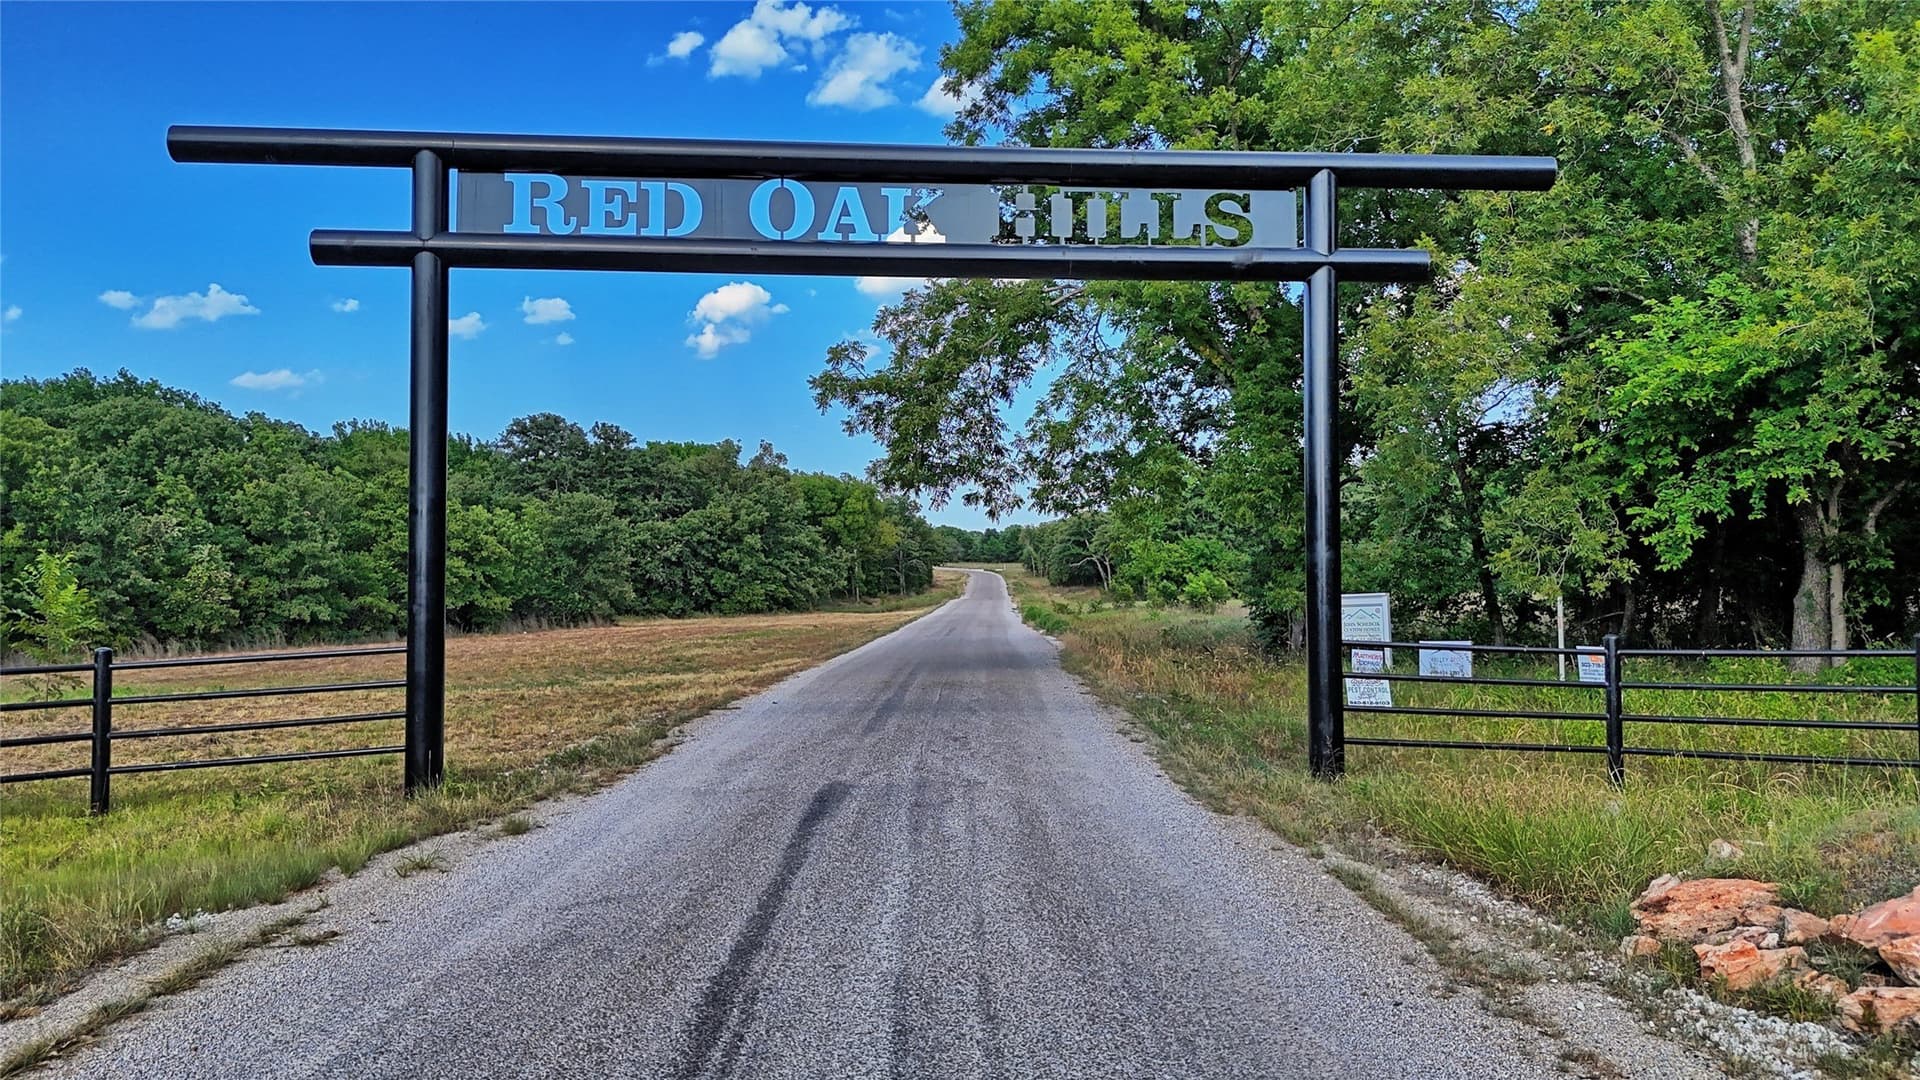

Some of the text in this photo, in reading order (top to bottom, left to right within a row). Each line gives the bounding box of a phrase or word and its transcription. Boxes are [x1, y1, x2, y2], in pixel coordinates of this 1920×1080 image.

[502, 172, 1254, 248] RED OAK HILLS
